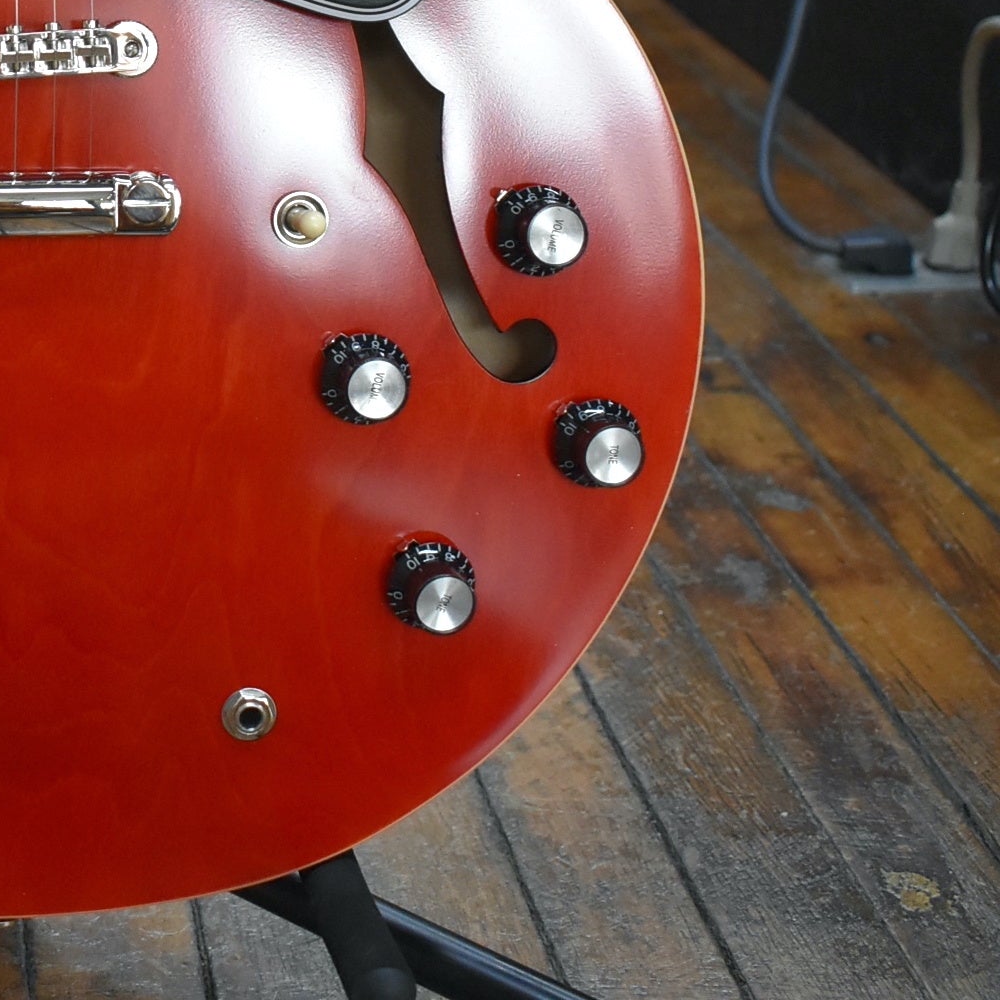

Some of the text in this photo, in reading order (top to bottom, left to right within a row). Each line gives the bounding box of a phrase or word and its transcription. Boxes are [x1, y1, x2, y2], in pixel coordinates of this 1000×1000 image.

[547, 219, 565, 253] VOLUME
[607, 445, 620, 465] TONE
[436, 594, 453, 613] TONE
